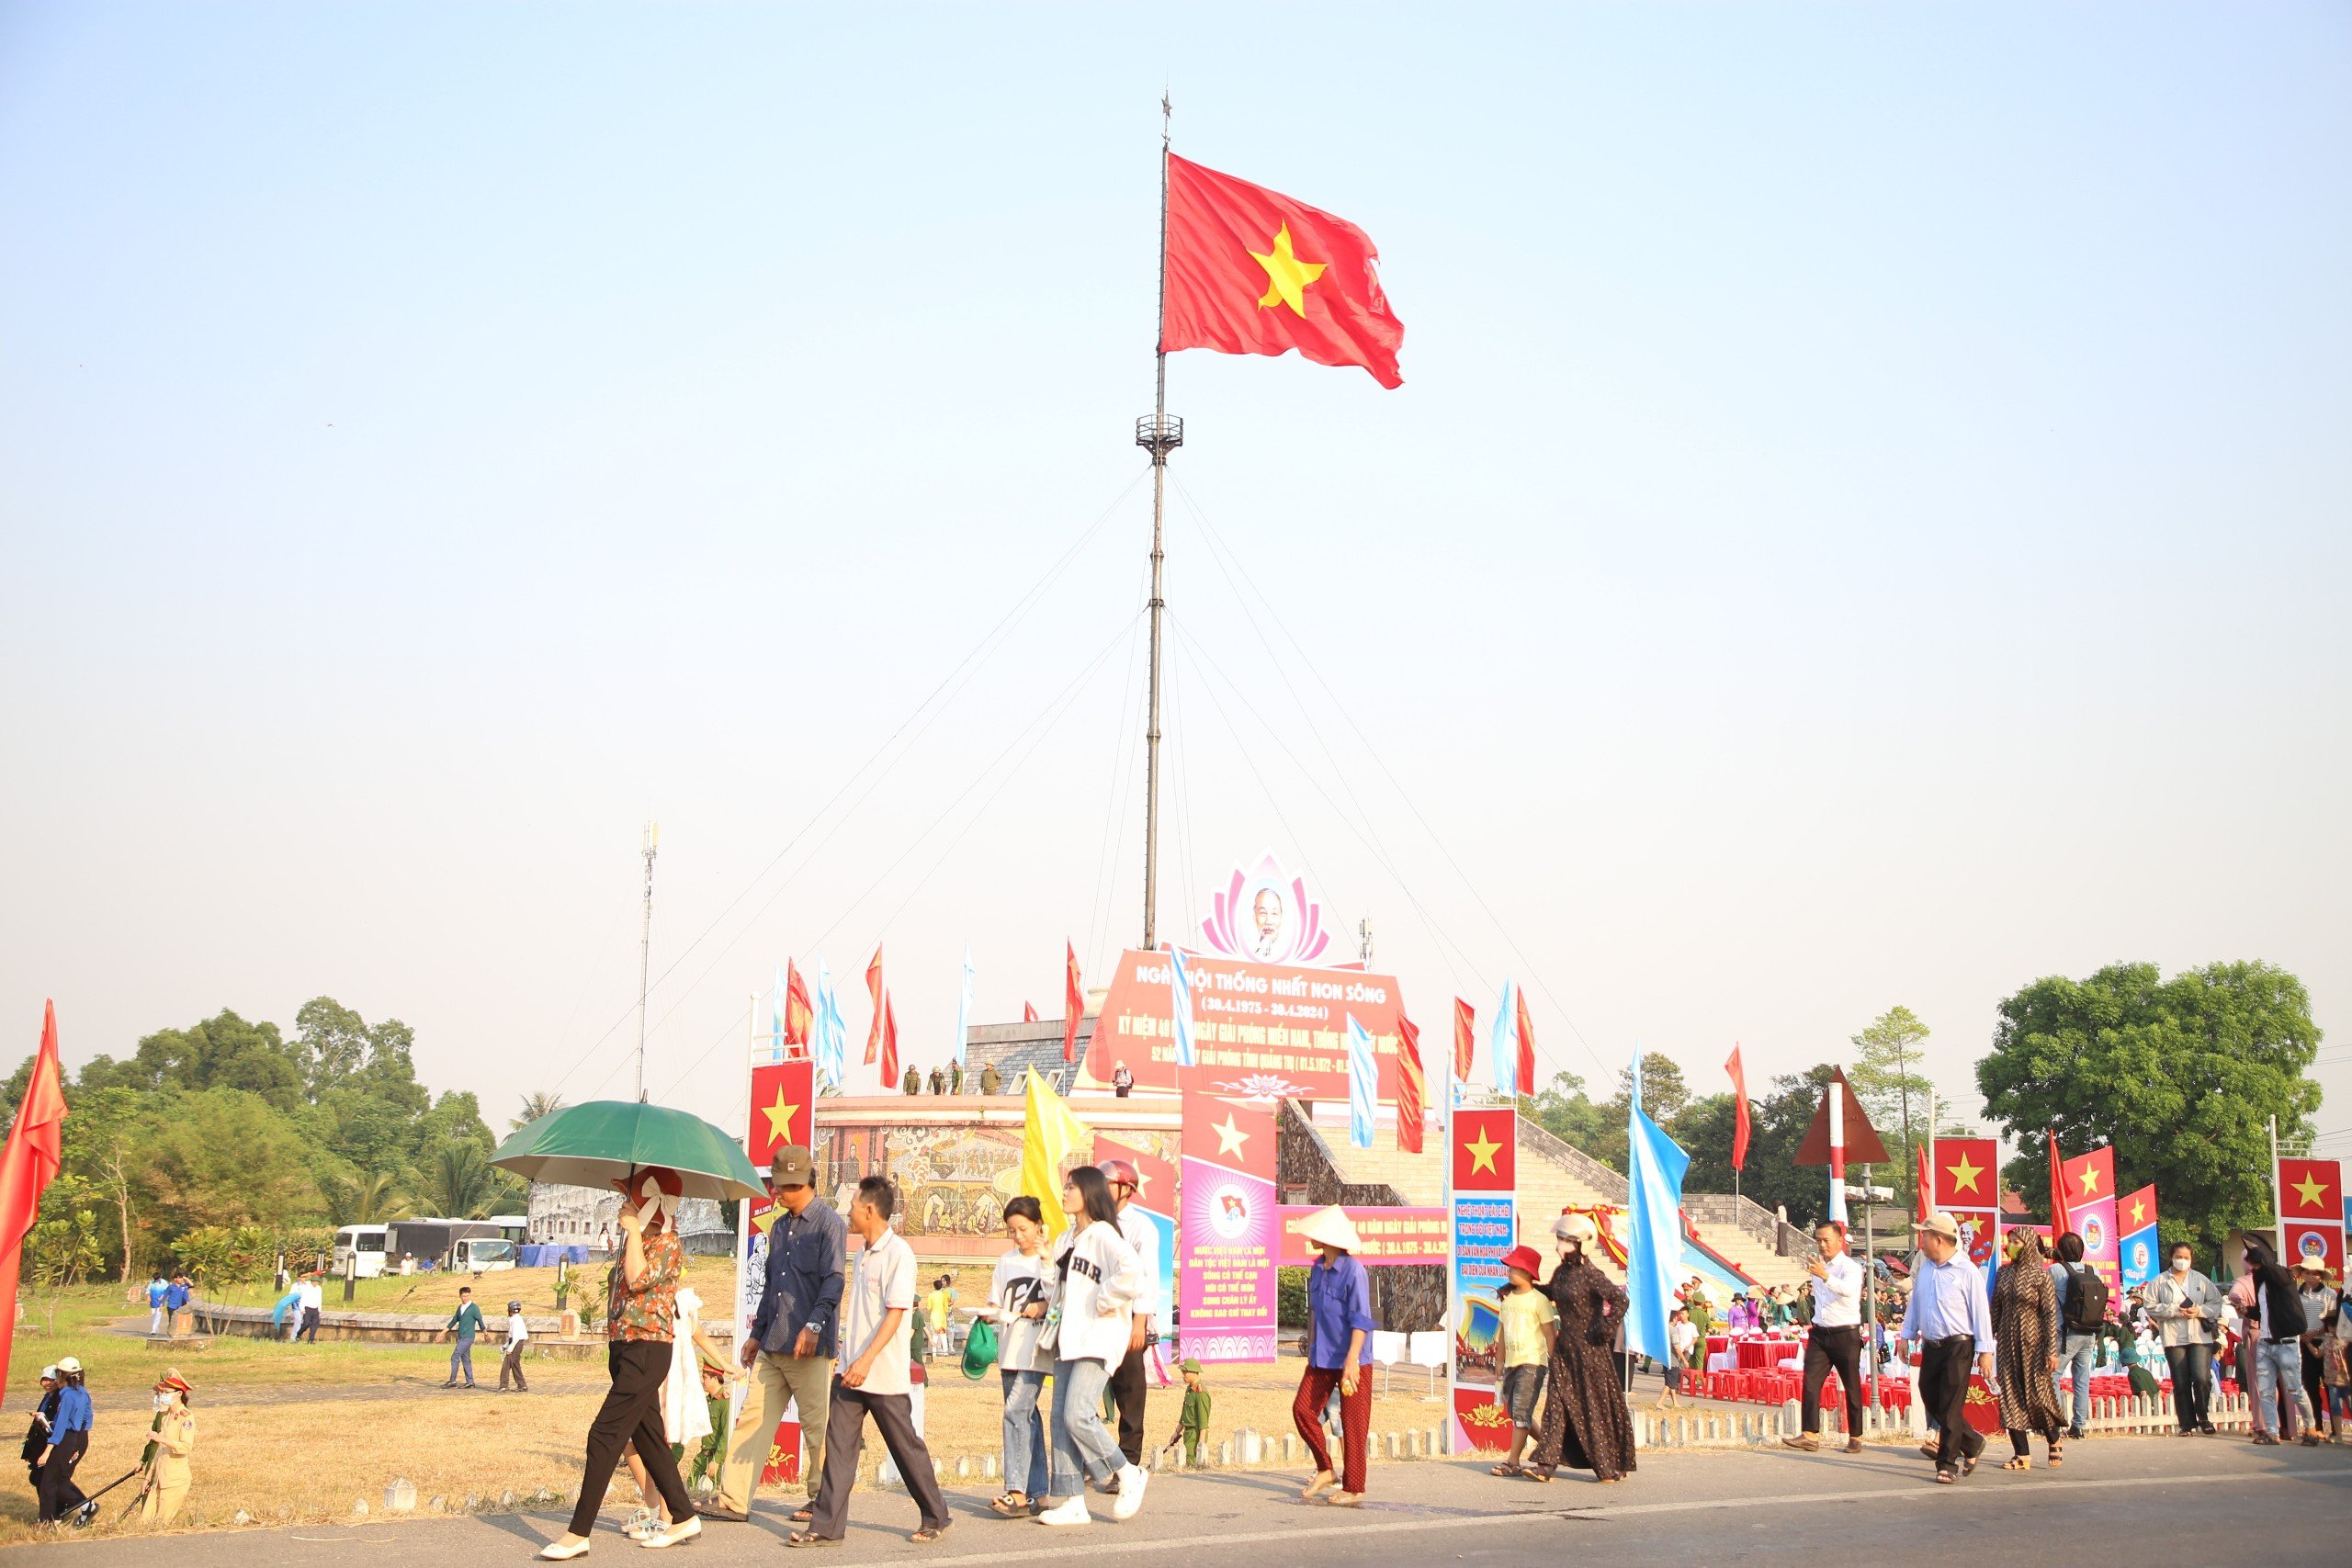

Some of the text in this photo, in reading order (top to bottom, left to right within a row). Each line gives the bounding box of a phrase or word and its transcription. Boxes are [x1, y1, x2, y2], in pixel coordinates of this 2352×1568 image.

[1136, 964, 1386, 1005] NGÀ HỘI THỐNG NHẤT NON SÔNG
[1132, 1013, 1157, 1040] NIỆM
[1159, 1019, 1170, 1038] 49
[1194, 1018, 1217, 1042] NGÀY
[1218, 1016, 1237, 1043] GIẢI
[1238, 1021, 1266, 1045] PHÓNG
[1313, 1025, 1339, 1050] THỐNG
[1151, 1045, 1161, 1062] 52
